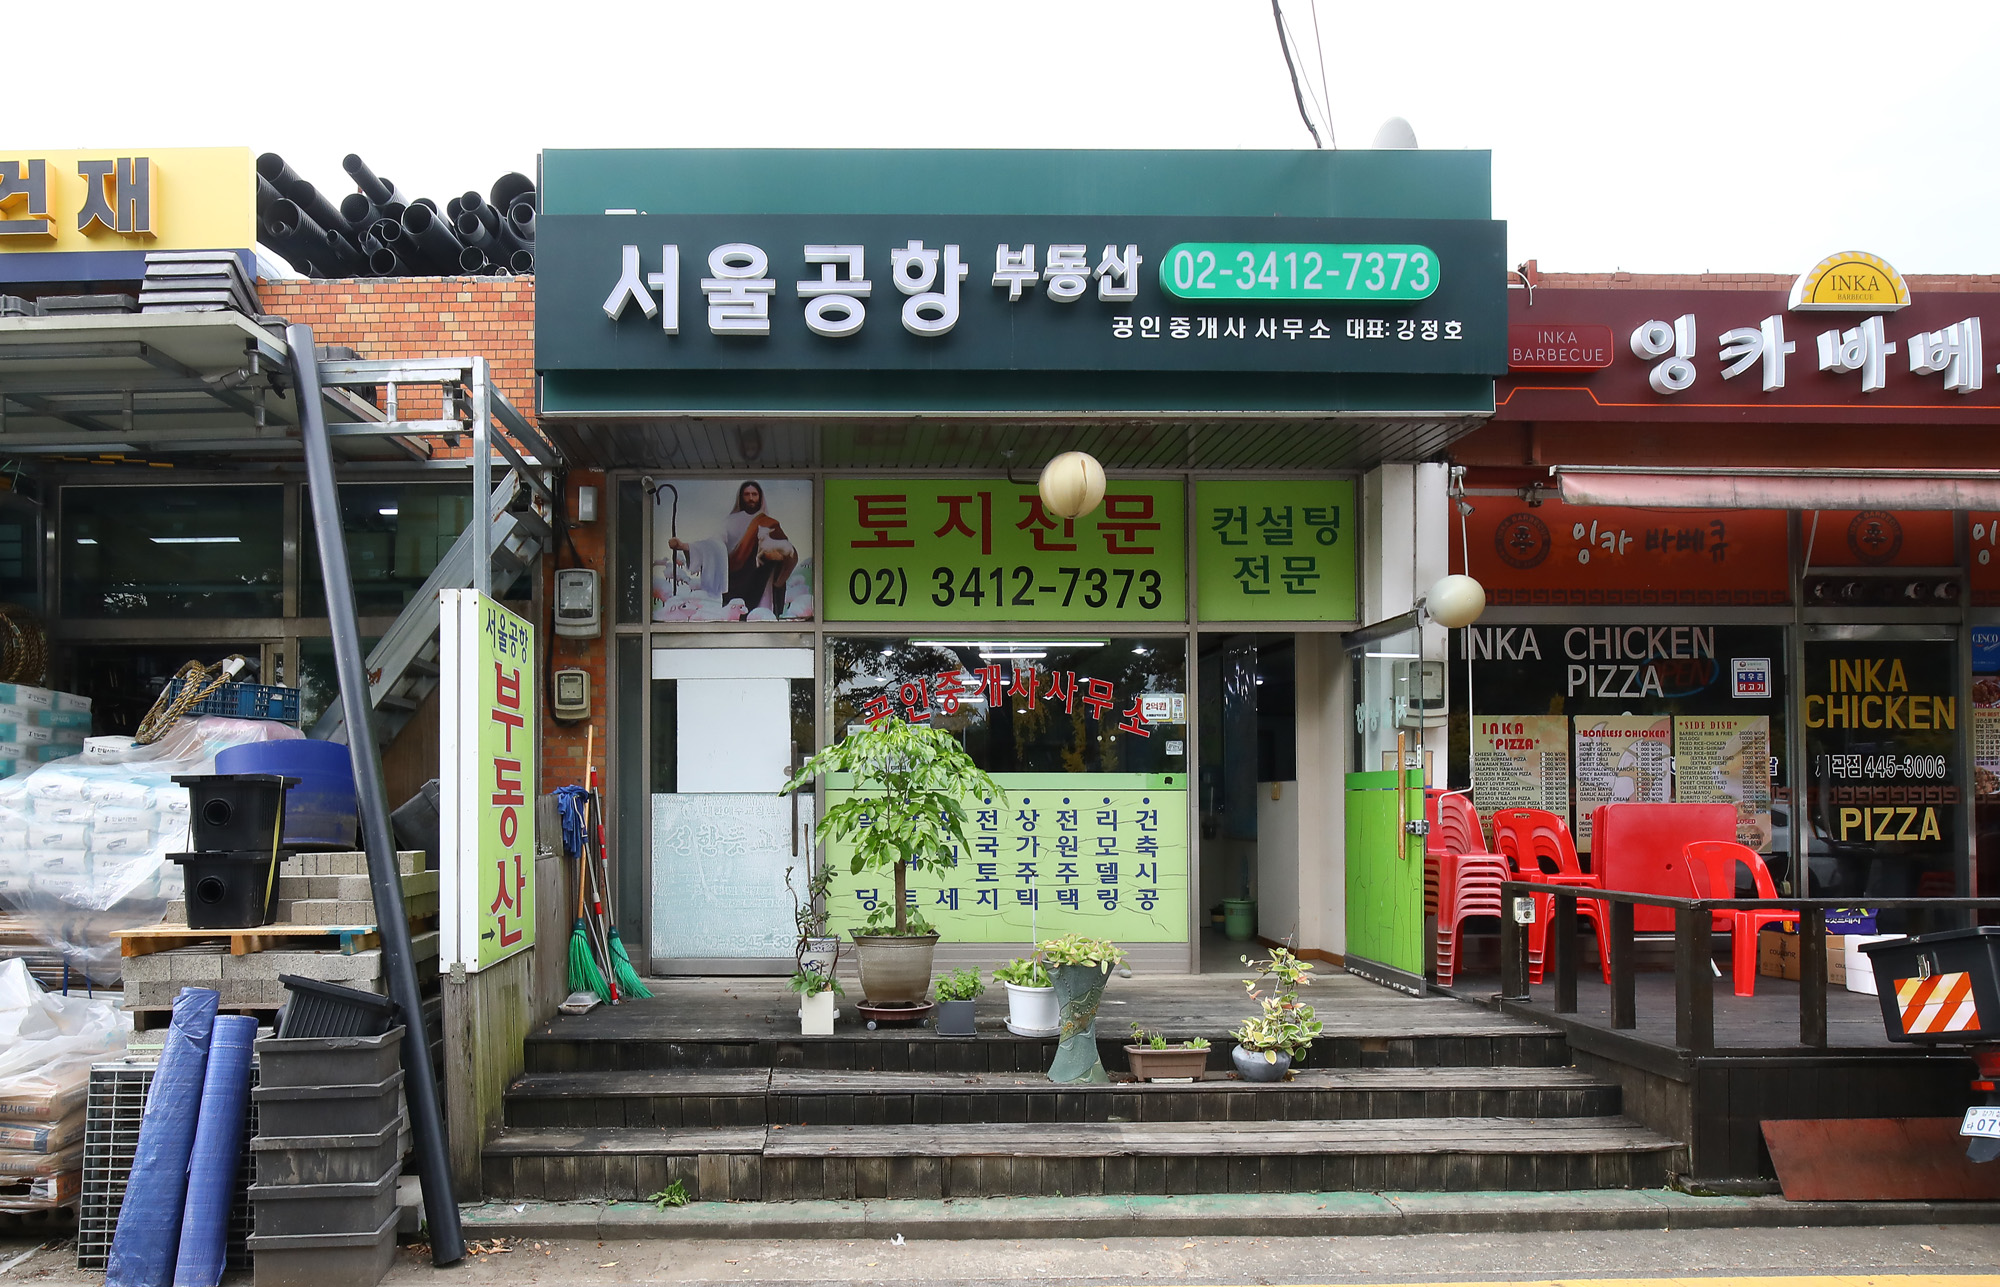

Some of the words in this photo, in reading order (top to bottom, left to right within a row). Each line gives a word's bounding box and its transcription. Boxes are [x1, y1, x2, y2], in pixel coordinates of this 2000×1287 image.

[1173, 249, 1430, 292] 02-3412-7373
[1830, 274, 1881, 292] INKA
[602, 240, 969, 338] 서울공항
[992, 243, 1143, 303] 부동산
[1837, 294, 1874, 302] BARBECUE
[1346, 318, 1390, 339] 대표:
[1397, 319, 1463, 341] 강정호
[1537, 330, 1578, 344] INKA
[1512, 347, 1604, 363] BARBECUE
[1630, 313, 2000, 396] 잉카바베
[850, 491, 1162, 555] 토지전문
[1211, 505, 1342, 546] 컨설팅
[1572, 519, 1633, 565] 잉카
[1645, 519, 1729, 564] 바베큐
[848, 567, 908, 607] 02)
[930, 566, 1163, 609] 3412-7373
[1233, 555, 1321, 596] 전문
[485, 606, 529, 665] 서울공항
[1459, 627, 1542, 661] INKA
[1563, 626, 1716, 661] CHICKEN
[1972, 634, 1999, 643] CESCO
[1567, 664, 1665, 699] PIZZA
[1829, 658, 1908, 694] INKA
[1145, 702, 1167, 710] 2억원
[1805, 695, 1956, 730] CHICKEN
[1482, 723, 1524, 734] INKA
[1582, 730, 1622, 738] BONELESS
[1624, 730, 1666, 738] CHICKEN
[1684, 721, 1706, 730] SIDE
[1710, 721, 1732, 730] DISH
[1496, 738, 1534, 750] PIZZA
[1815, 754, 1863, 779] 곡점
[1864, 754, 1946, 780] 445-3006
[490, 658, 526, 949] 부동산
[1840, 806, 1942, 842] PIZZA
[975, 809, 999, 911] 전국토지
[1014, 809, 1041, 911] 상가주택
[1055, 809, 1080, 911] 전원주택
[1094, 809, 1119, 911] 리모델링
[1135, 809, 1160, 911] 건축시공
[1770, 948, 1796, 959] couang
[1977, 1118, 2000, 1132] 07
